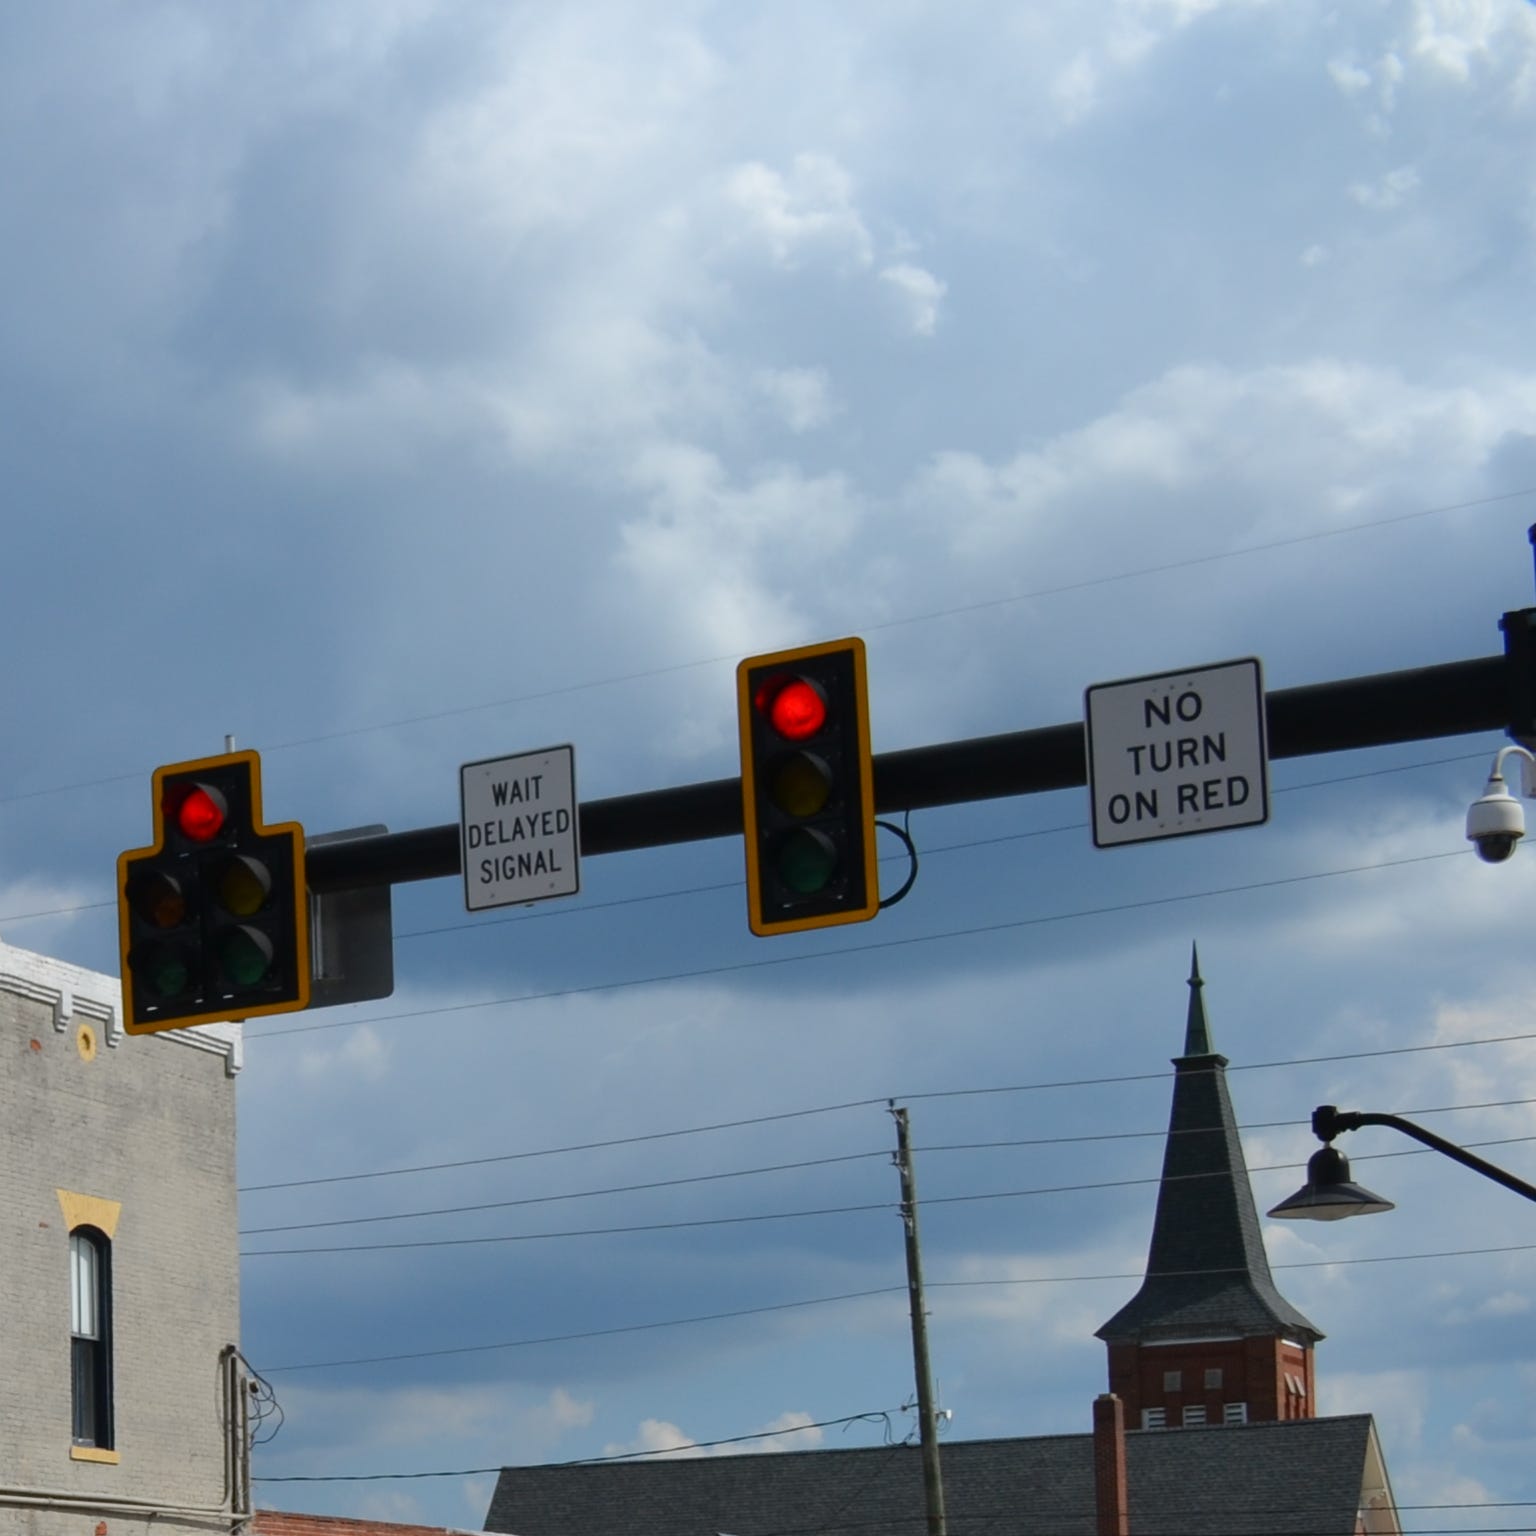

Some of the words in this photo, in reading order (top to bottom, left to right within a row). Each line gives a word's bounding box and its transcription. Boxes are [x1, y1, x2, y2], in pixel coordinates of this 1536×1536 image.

[1144, 691, 1202, 728] NO
[1126, 732, 1226, 776] TURN
[492, 775, 543, 807] WAIT
[1108, 789, 1158, 824] ON
[1177, 776, 1250, 815] RED
[469, 808, 570, 849] DELAYED
[480, 848, 562, 884] SIGNAL
